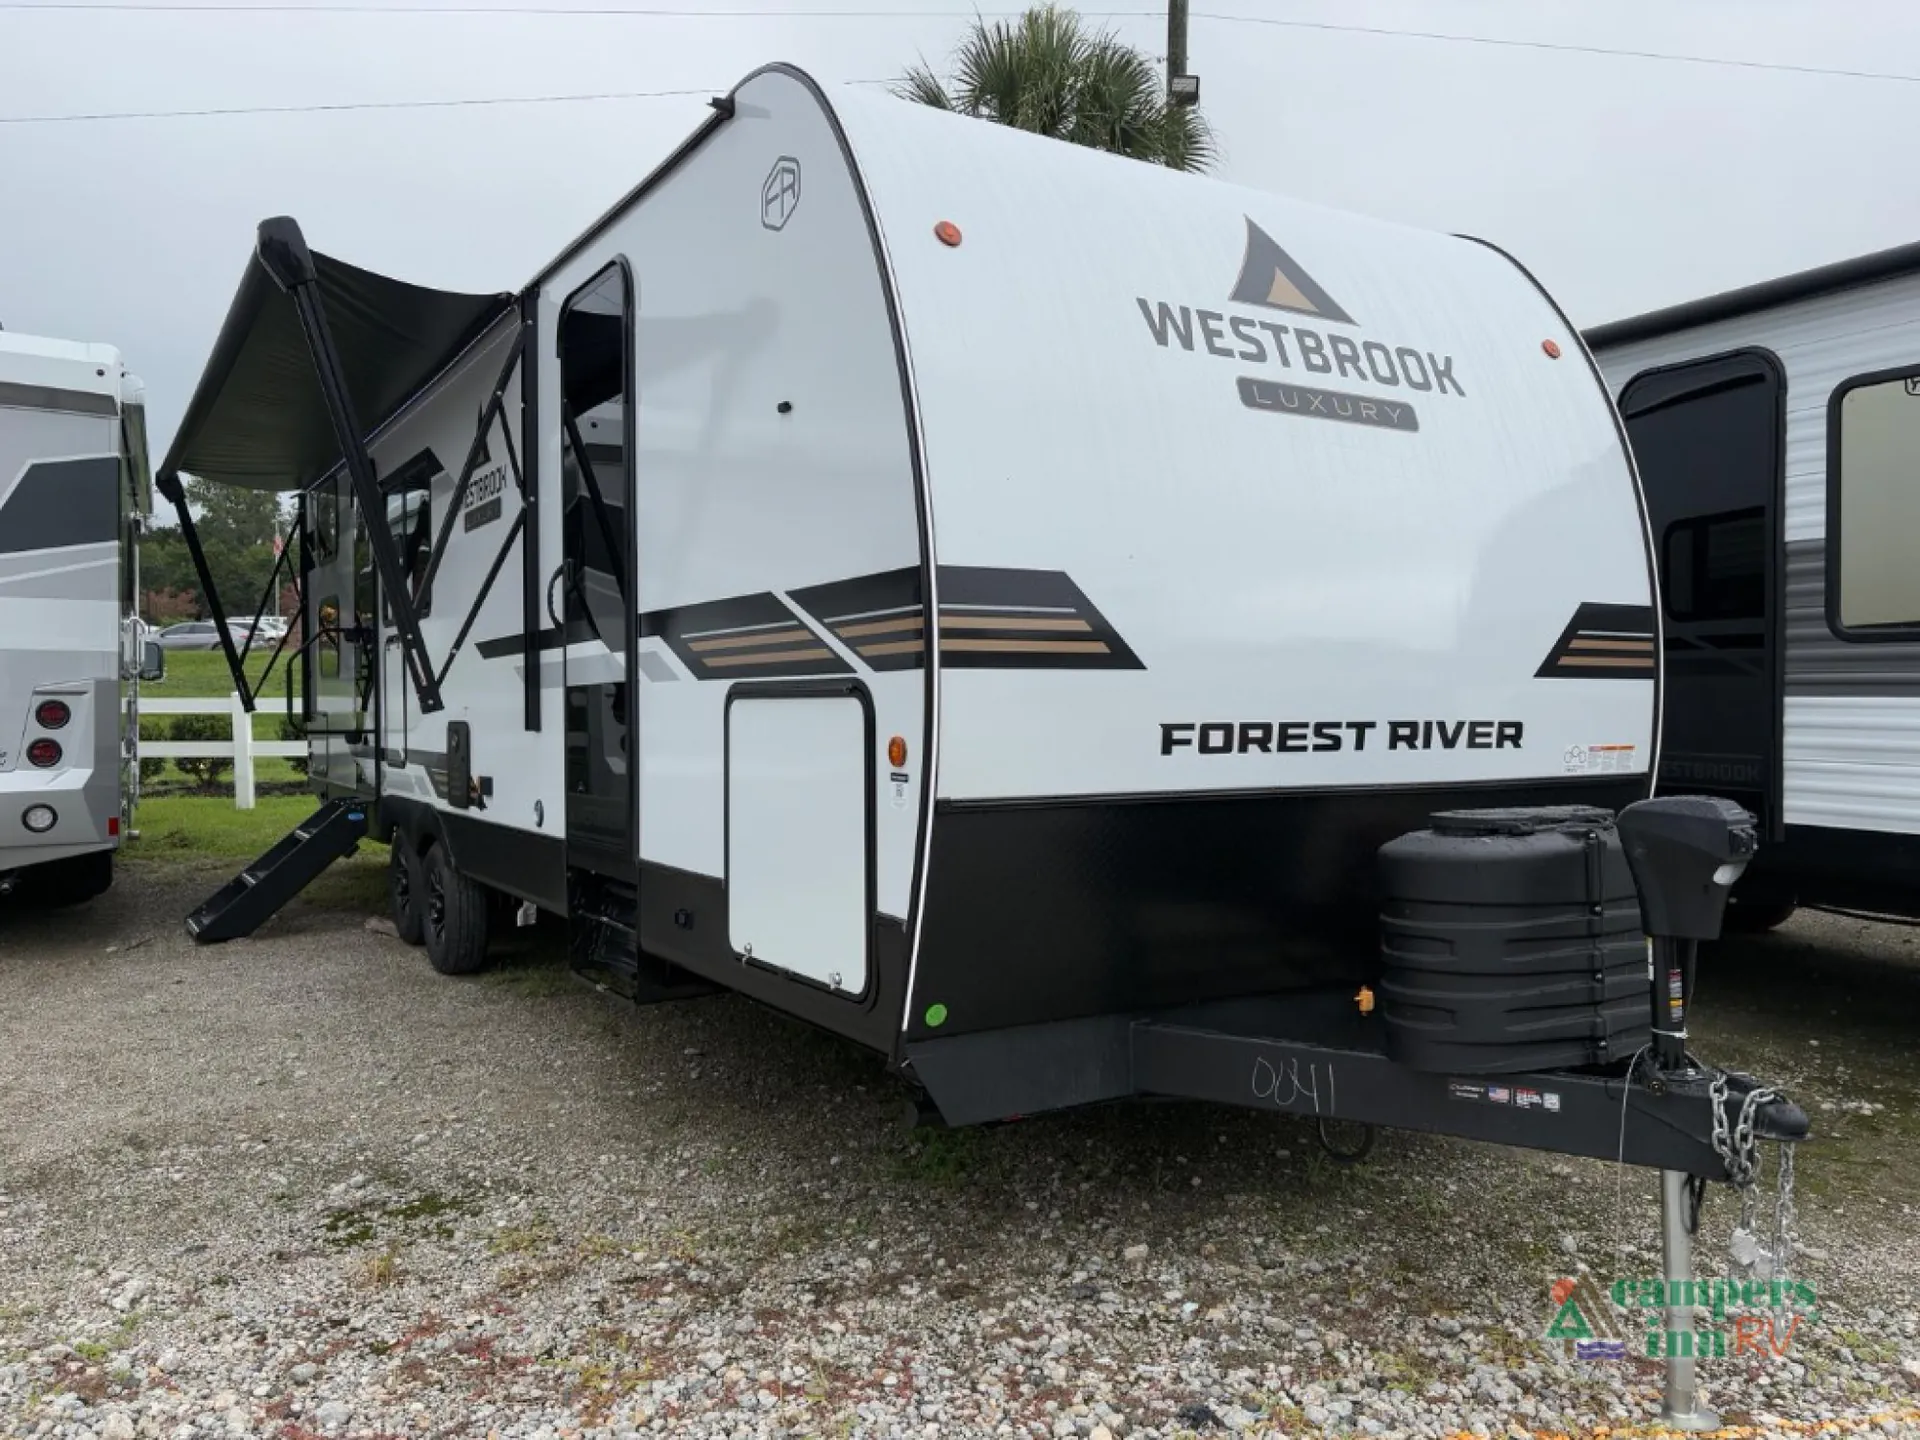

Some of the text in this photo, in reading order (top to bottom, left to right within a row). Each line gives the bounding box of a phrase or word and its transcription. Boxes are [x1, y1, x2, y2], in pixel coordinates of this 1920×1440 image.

[1136, 297, 1466, 398] WESTBROOK
[1252, 384, 1402, 424] LUXURY
[462, 464, 507, 509] ESTBROOK
[1159, 720, 1524, 756] FOREST RIVER
